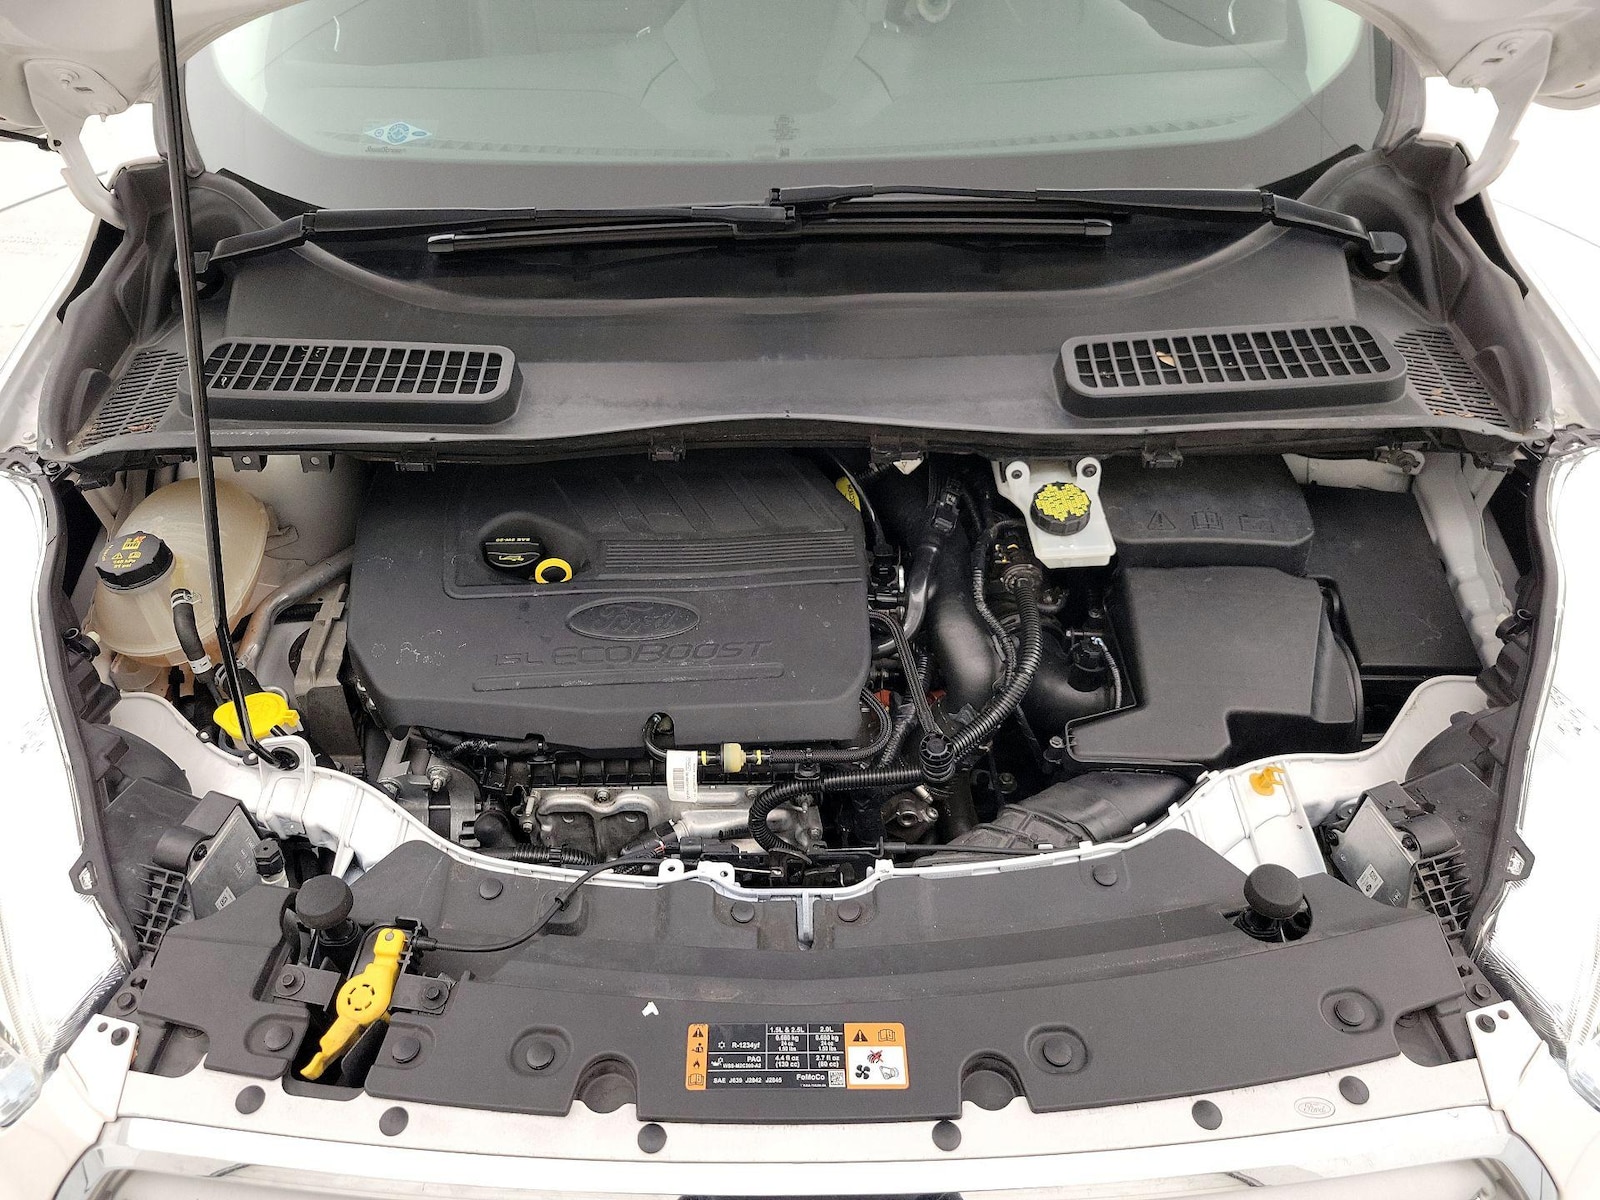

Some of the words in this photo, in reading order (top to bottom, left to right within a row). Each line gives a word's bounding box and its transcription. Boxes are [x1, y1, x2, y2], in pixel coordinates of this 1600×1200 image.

[791, 1035, 800, 1043] kg
[831, 1035, 839, 1043] kg
[731, 1041, 761, 1050] R-1234yf
[796, 1073, 826, 1081] FoMoCo
